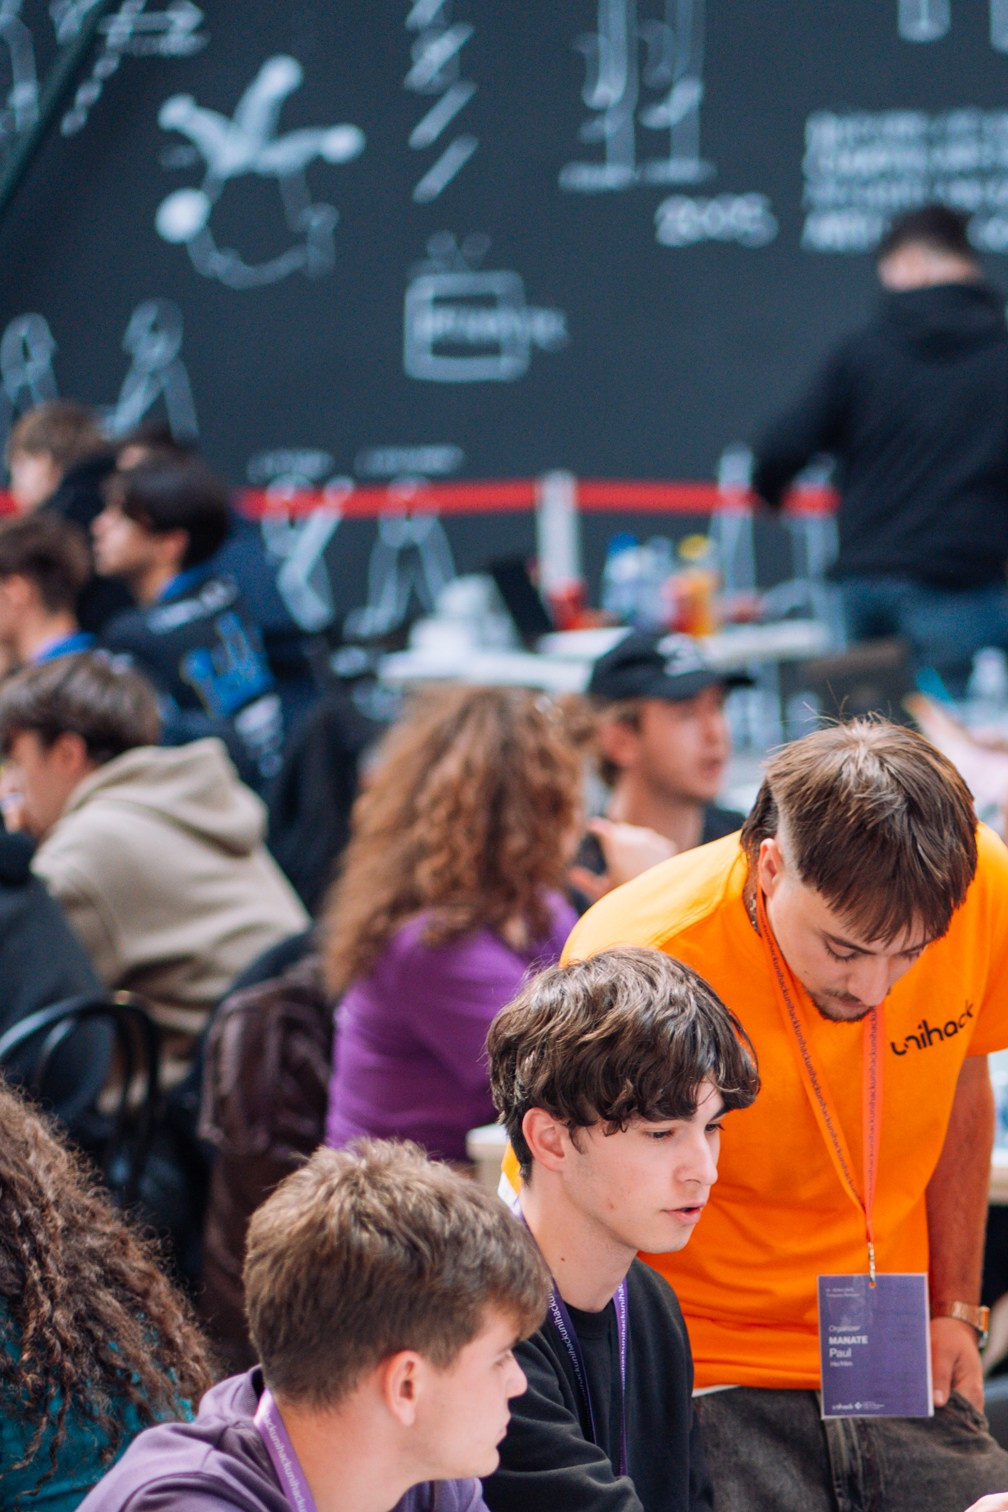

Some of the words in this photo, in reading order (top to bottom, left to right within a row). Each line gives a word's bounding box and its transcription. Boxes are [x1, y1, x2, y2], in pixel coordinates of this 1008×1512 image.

[890, 999, 975, 1056] unihack
[828, 1335, 869, 1345] MANATE
[828, 1347, 852, 1359] Paul
